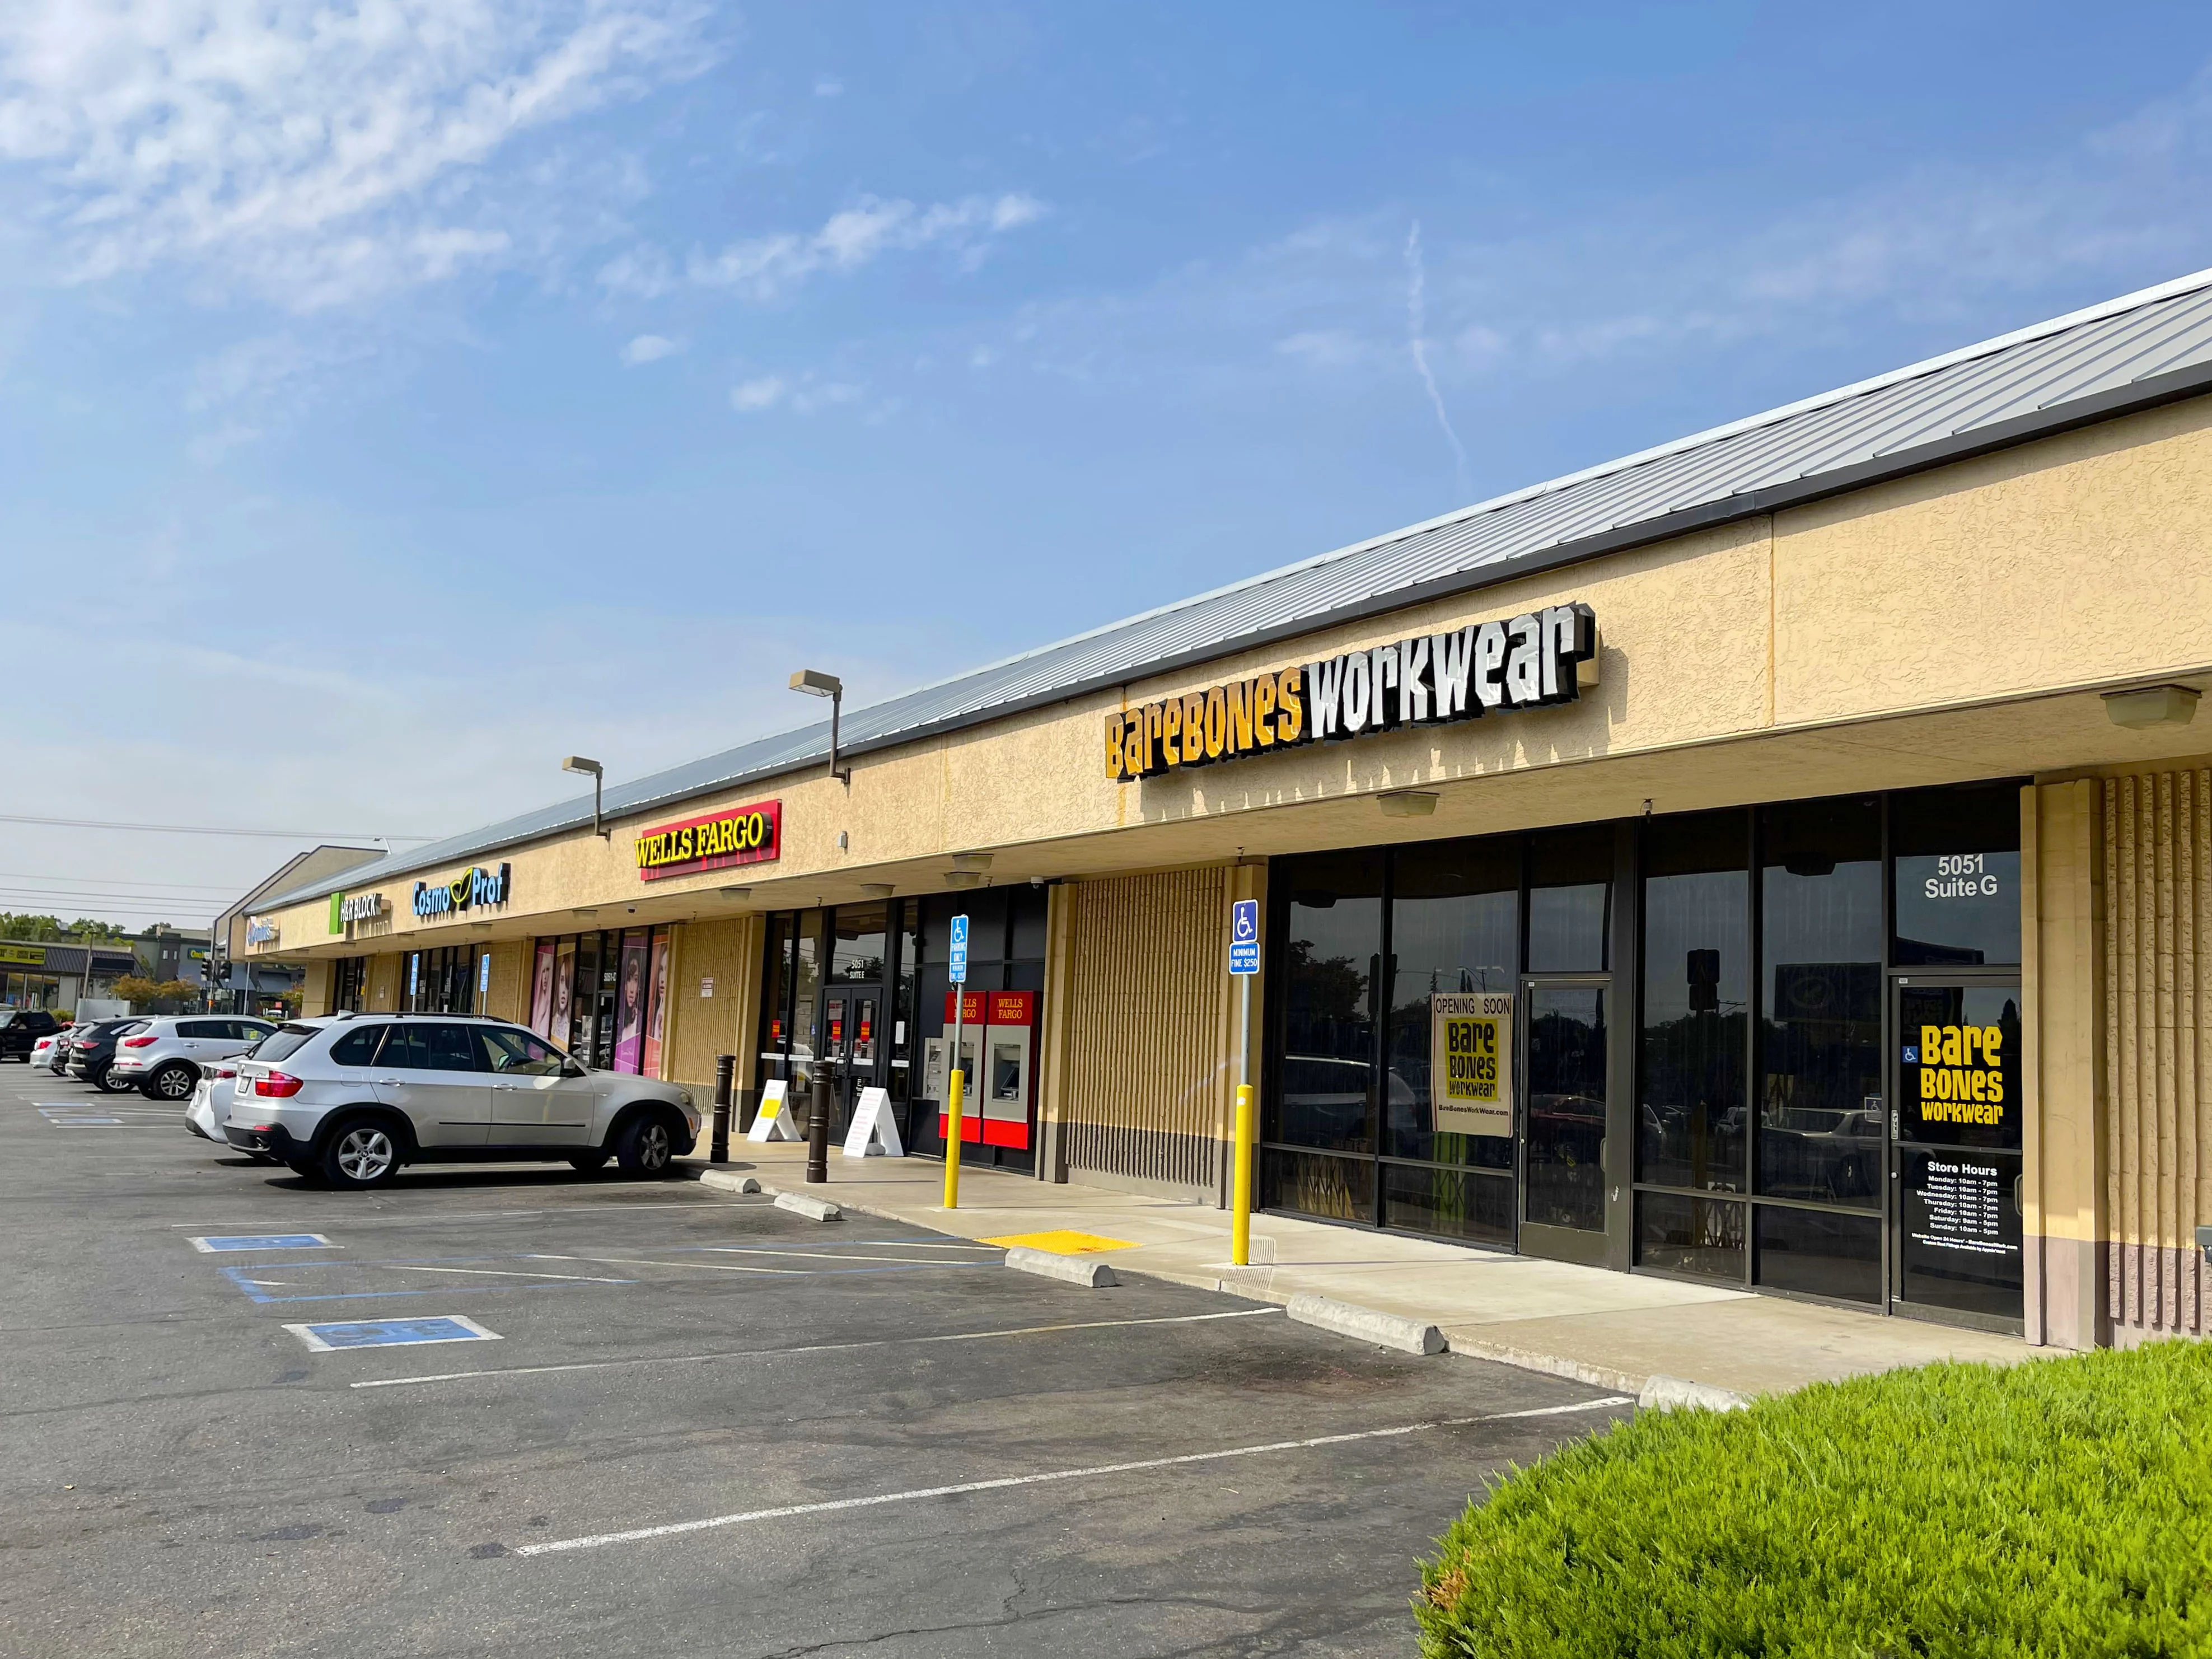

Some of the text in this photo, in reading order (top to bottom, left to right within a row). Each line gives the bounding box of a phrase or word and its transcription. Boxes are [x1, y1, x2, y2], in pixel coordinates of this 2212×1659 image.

[634, 812, 763, 868] WELLS FARGO
[1938, 853, 1984, 876] 5051
[412, 862, 503, 916] Cosmo Prof
[1925, 875, 1998, 899] Suite G
[340, 893, 376, 923] H&R BLOCK
[1233, 947, 1256, 957] MINIMUM
[851, 959, 864, 969] 5051
[1231, 958, 1257, 968] FINE $250
[861, 970, 865, 979] E
[998, 998, 1023, 1008] WELLS
[1435, 998, 1510, 1015] OPENING SOON
[954, 1009, 976, 1018] RGO
[998, 1009, 1023, 1019] FARGO
[1448, 1022, 1495, 1053] Bare
[1921, 1025, 2003, 1066] Bare
[1928, 1161, 1998, 1176] Store Hours
[1928, 1175, 1957, 1184] Monday:
[1927, 1183, 1957, 1193] Tuesday:
[1916, 1190, 1957, 1200] Wednesday:
[1923, 1198, 1957, 1207] Thursday:
[1934, 1207, 1957, 1216] Friday:
[1929, 1214, 1961, 1223] Saturday:
[1930, 1222, 1957, 1231] Sunday:
